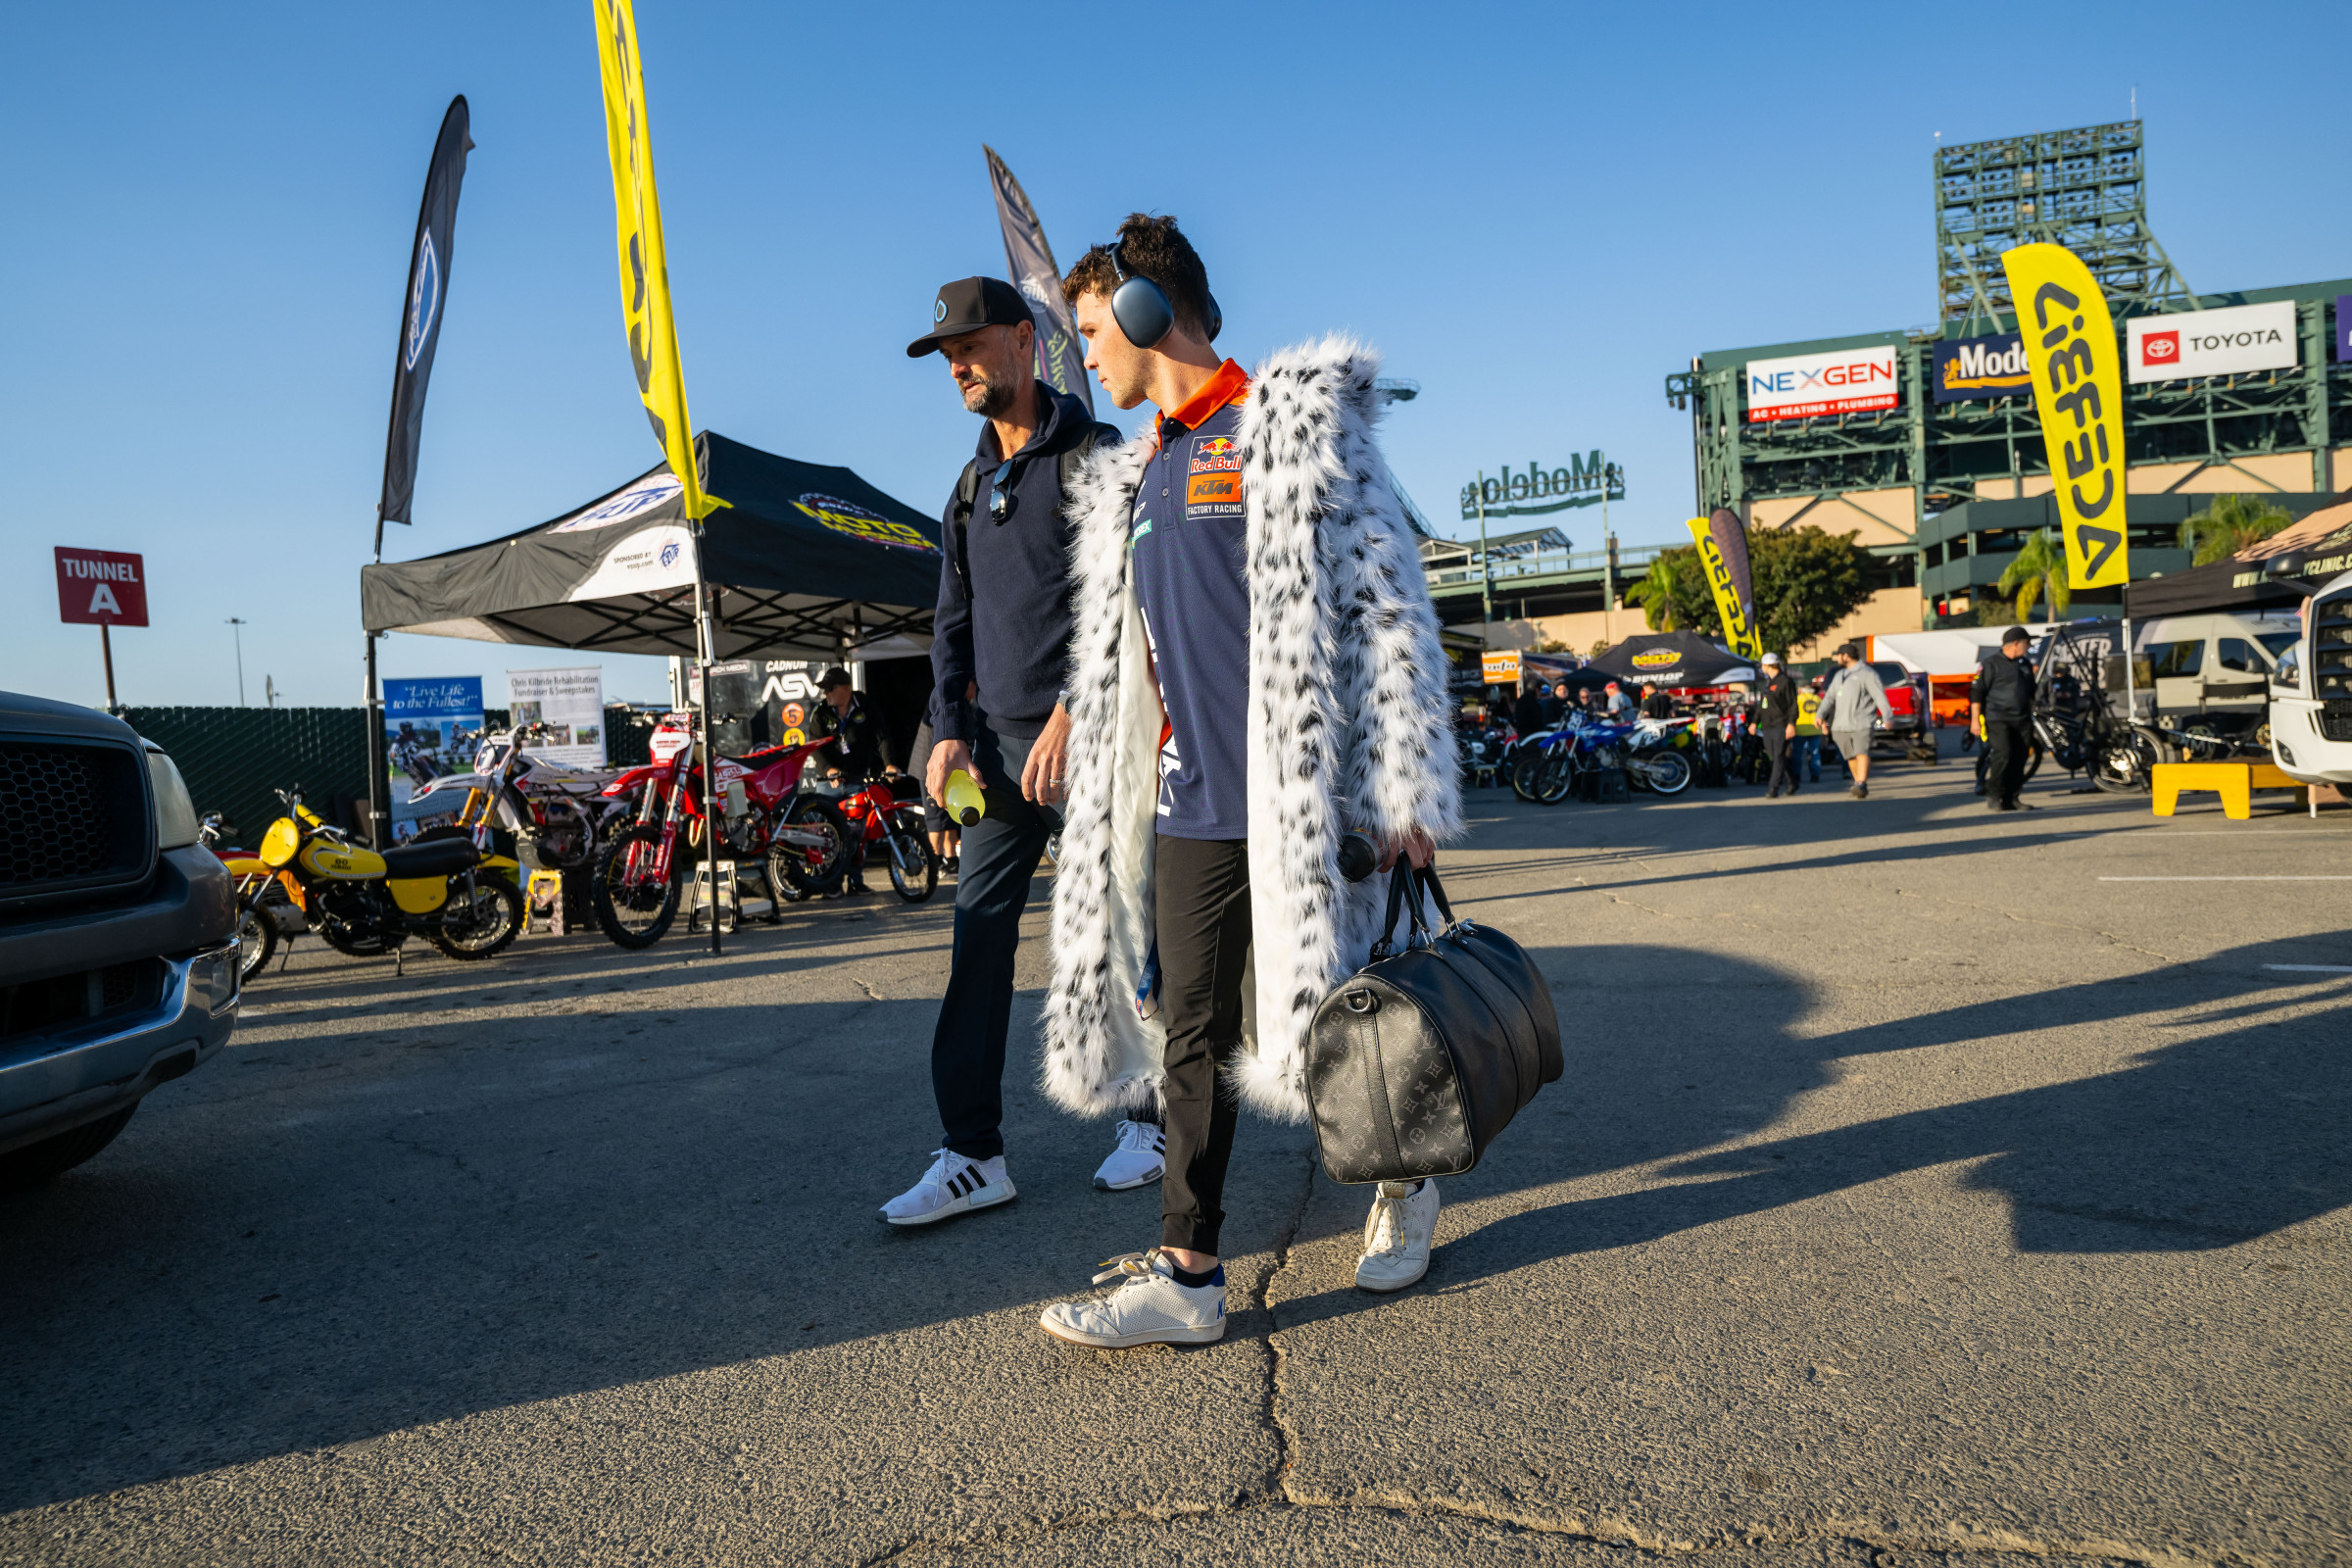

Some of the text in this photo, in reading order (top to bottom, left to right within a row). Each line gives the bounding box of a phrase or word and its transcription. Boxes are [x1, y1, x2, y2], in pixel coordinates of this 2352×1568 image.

[2189, 328, 2282, 352] TOYOTA
[1752, 360, 1892, 395] NEXGEN
[1752, 395, 1894, 419] AC HEATING PLUMBING
[1190, 455, 1243, 473] Red Bull
[1193, 479, 1234, 497] KTM
[1187, 504, 1243, 515] FACTORY RACING
[792, 501, 923, 539] MOTO
[613, 552, 644, 564] SPONSORED
[62, 558, 139, 583] TUNNEL
[88, 583, 122, 615] A
[765, 660, 808, 673] CADNUM
[511, 674, 599, 688] Chris Kilbride Rehabilitation
[440, 683, 466, 697] Life
[514, 685, 596, 698] Fundraiser & Sweepstakes
[392, 699, 406, 710] to
[407, 697, 426, 710] the
[788, 709, 798, 724] 5
